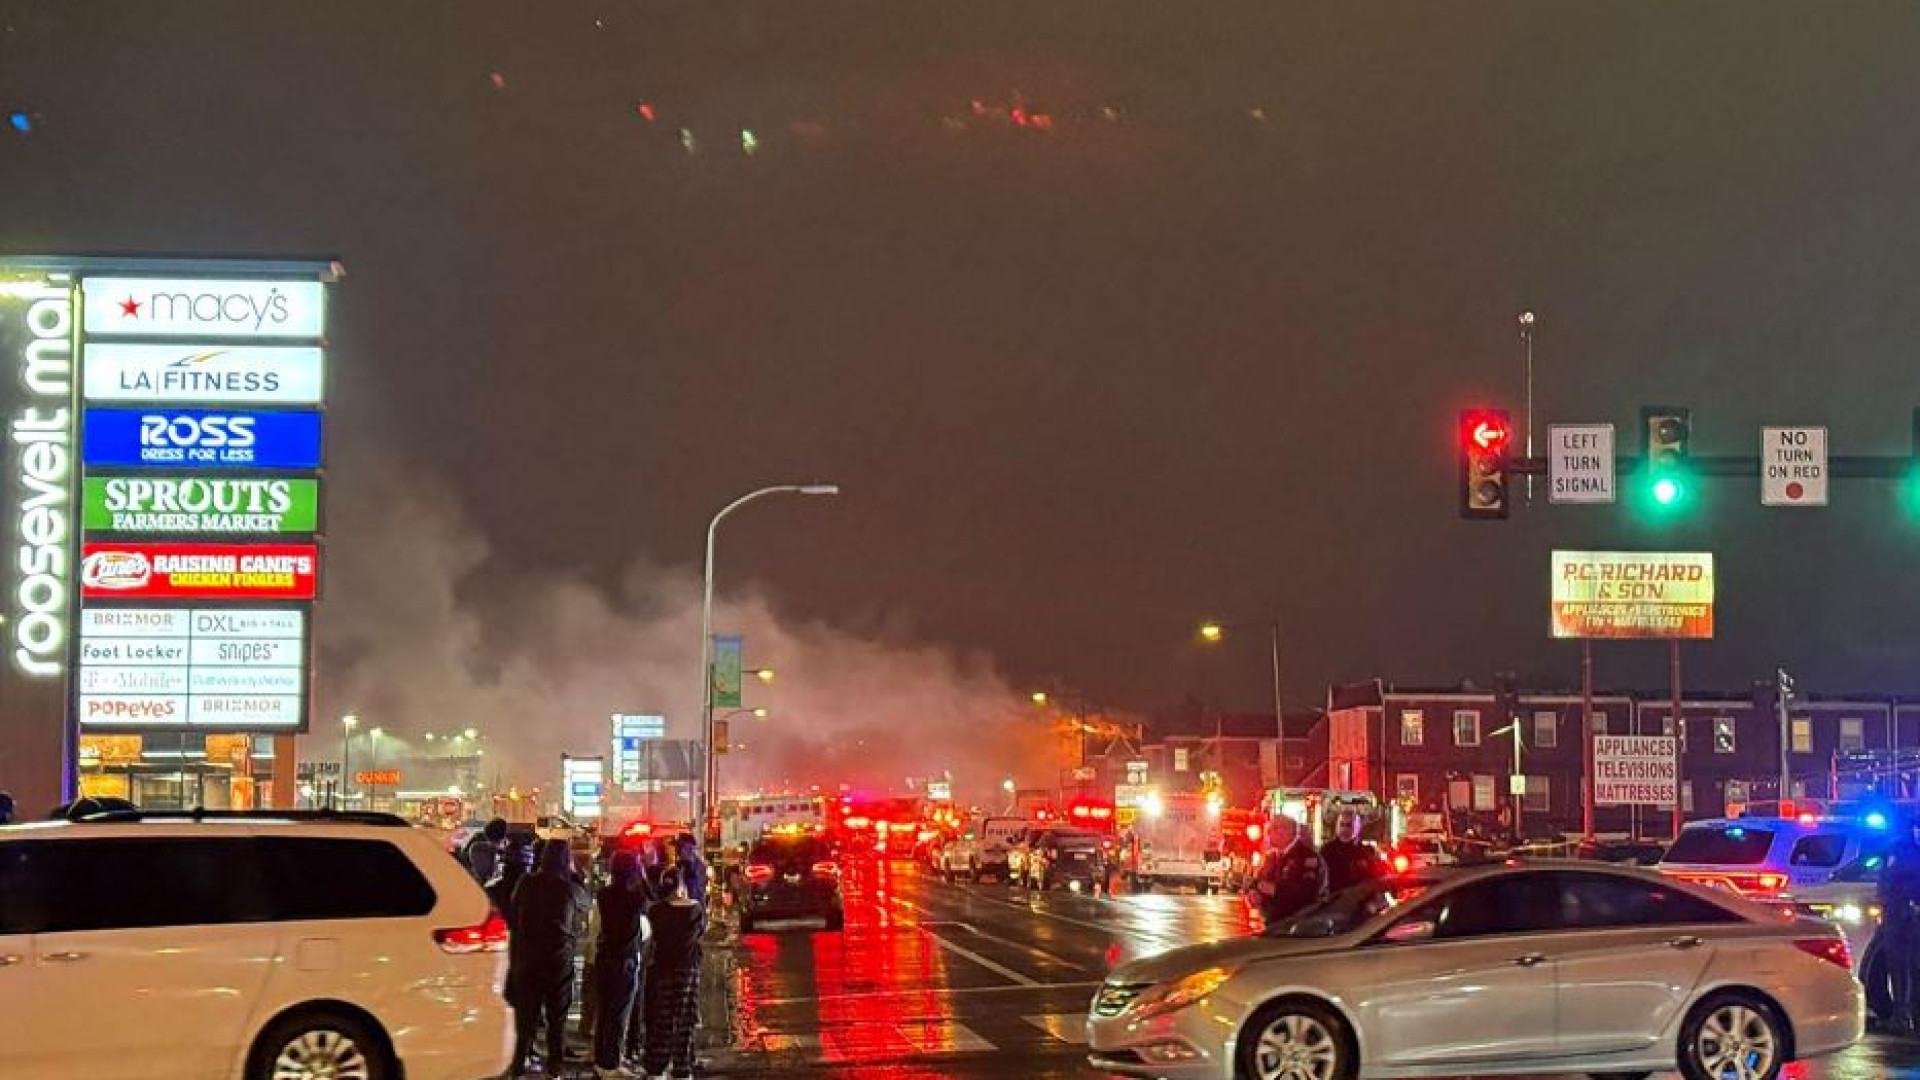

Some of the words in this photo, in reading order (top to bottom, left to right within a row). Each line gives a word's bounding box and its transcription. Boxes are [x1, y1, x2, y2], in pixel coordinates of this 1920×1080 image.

[151, 288, 289, 331] macy's
[120, 370, 151, 391] LA
[163, 371, 279, 392] FITNESS
[141, 415, 256, 447] ROSS
[1780, 431, 1807, 445] NO
[1563, 433, 1598, 449] LEFT
[1563, 456, 1600, 471] TURN
[1776, 449, 1812, 462] TURN
[1768, 466, 1788, 478] ON
[1793, 466, 1820, 478] RED
[1555, 477, 1608, 493] SIGNAL
[105, 478, 290, 514] SPROUTS
[112, 513, 198, 530] FARMERS
[201, 513, 282, 531] MARKET
[12, 408, 68, 675] roosevelt
[153, 555, 237, 572] RAISING
[241, 556, 311, 573] CANE'S
[1600, 562, 1703, 581] RICHARD
[1618, 582, 1664, 599] SON
[197, 615, 240, 632] DXL
[83, 644, 119, 659] Foot
[126, 644, 183, 660] Locker
[1596, 738, 1674, 755] APPLIANCES
[1596, 760, 1674, 778] TELEVISIONS
[1596, 782, 1674, 801] MATTRESSES
